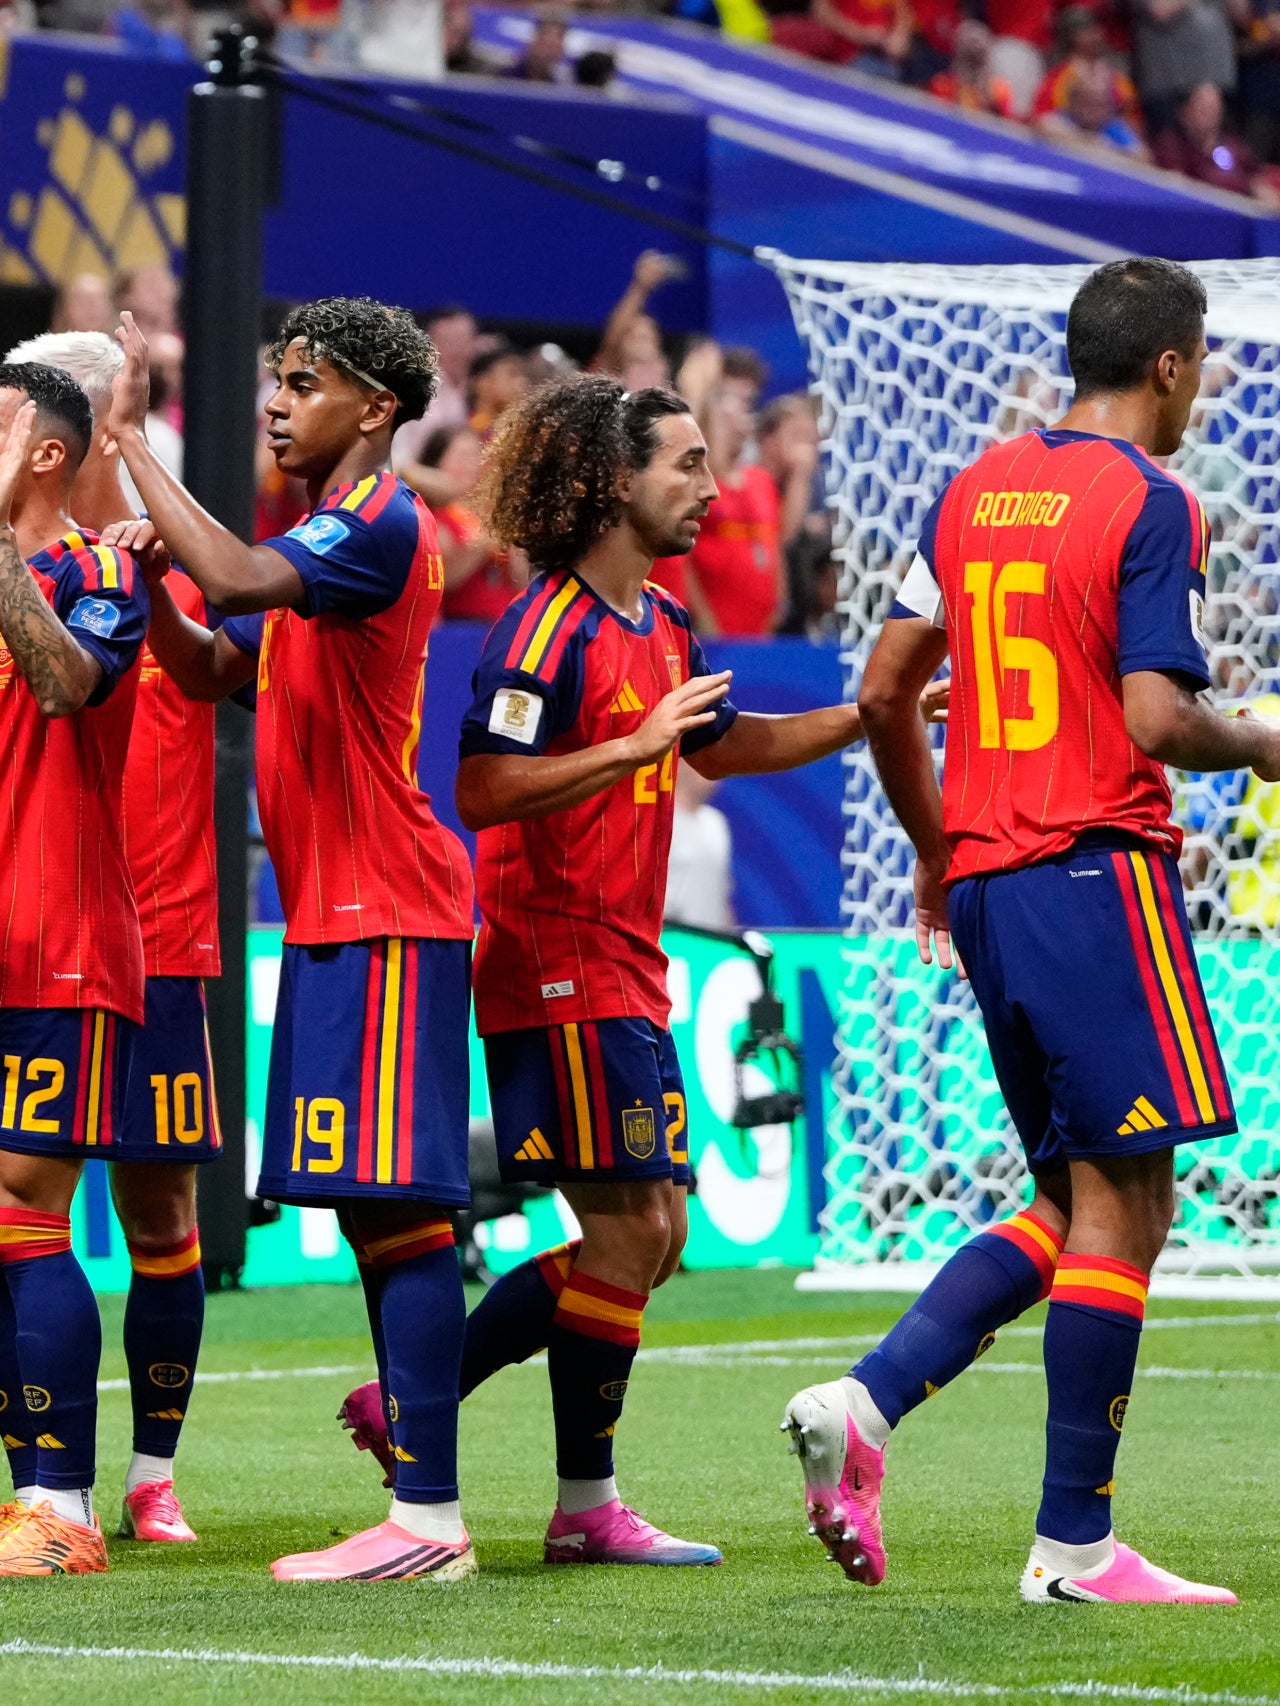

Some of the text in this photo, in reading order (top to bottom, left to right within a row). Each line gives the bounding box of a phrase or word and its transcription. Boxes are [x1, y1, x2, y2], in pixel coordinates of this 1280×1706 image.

[971, 491, 1071, 528] RODRIGO
[963, 560, 1060, 752] 16
[1, 1054, 65, 1134] 12
[150, 1071, 204, 1145] 10
[291, 1096, 346, 1174] 19
